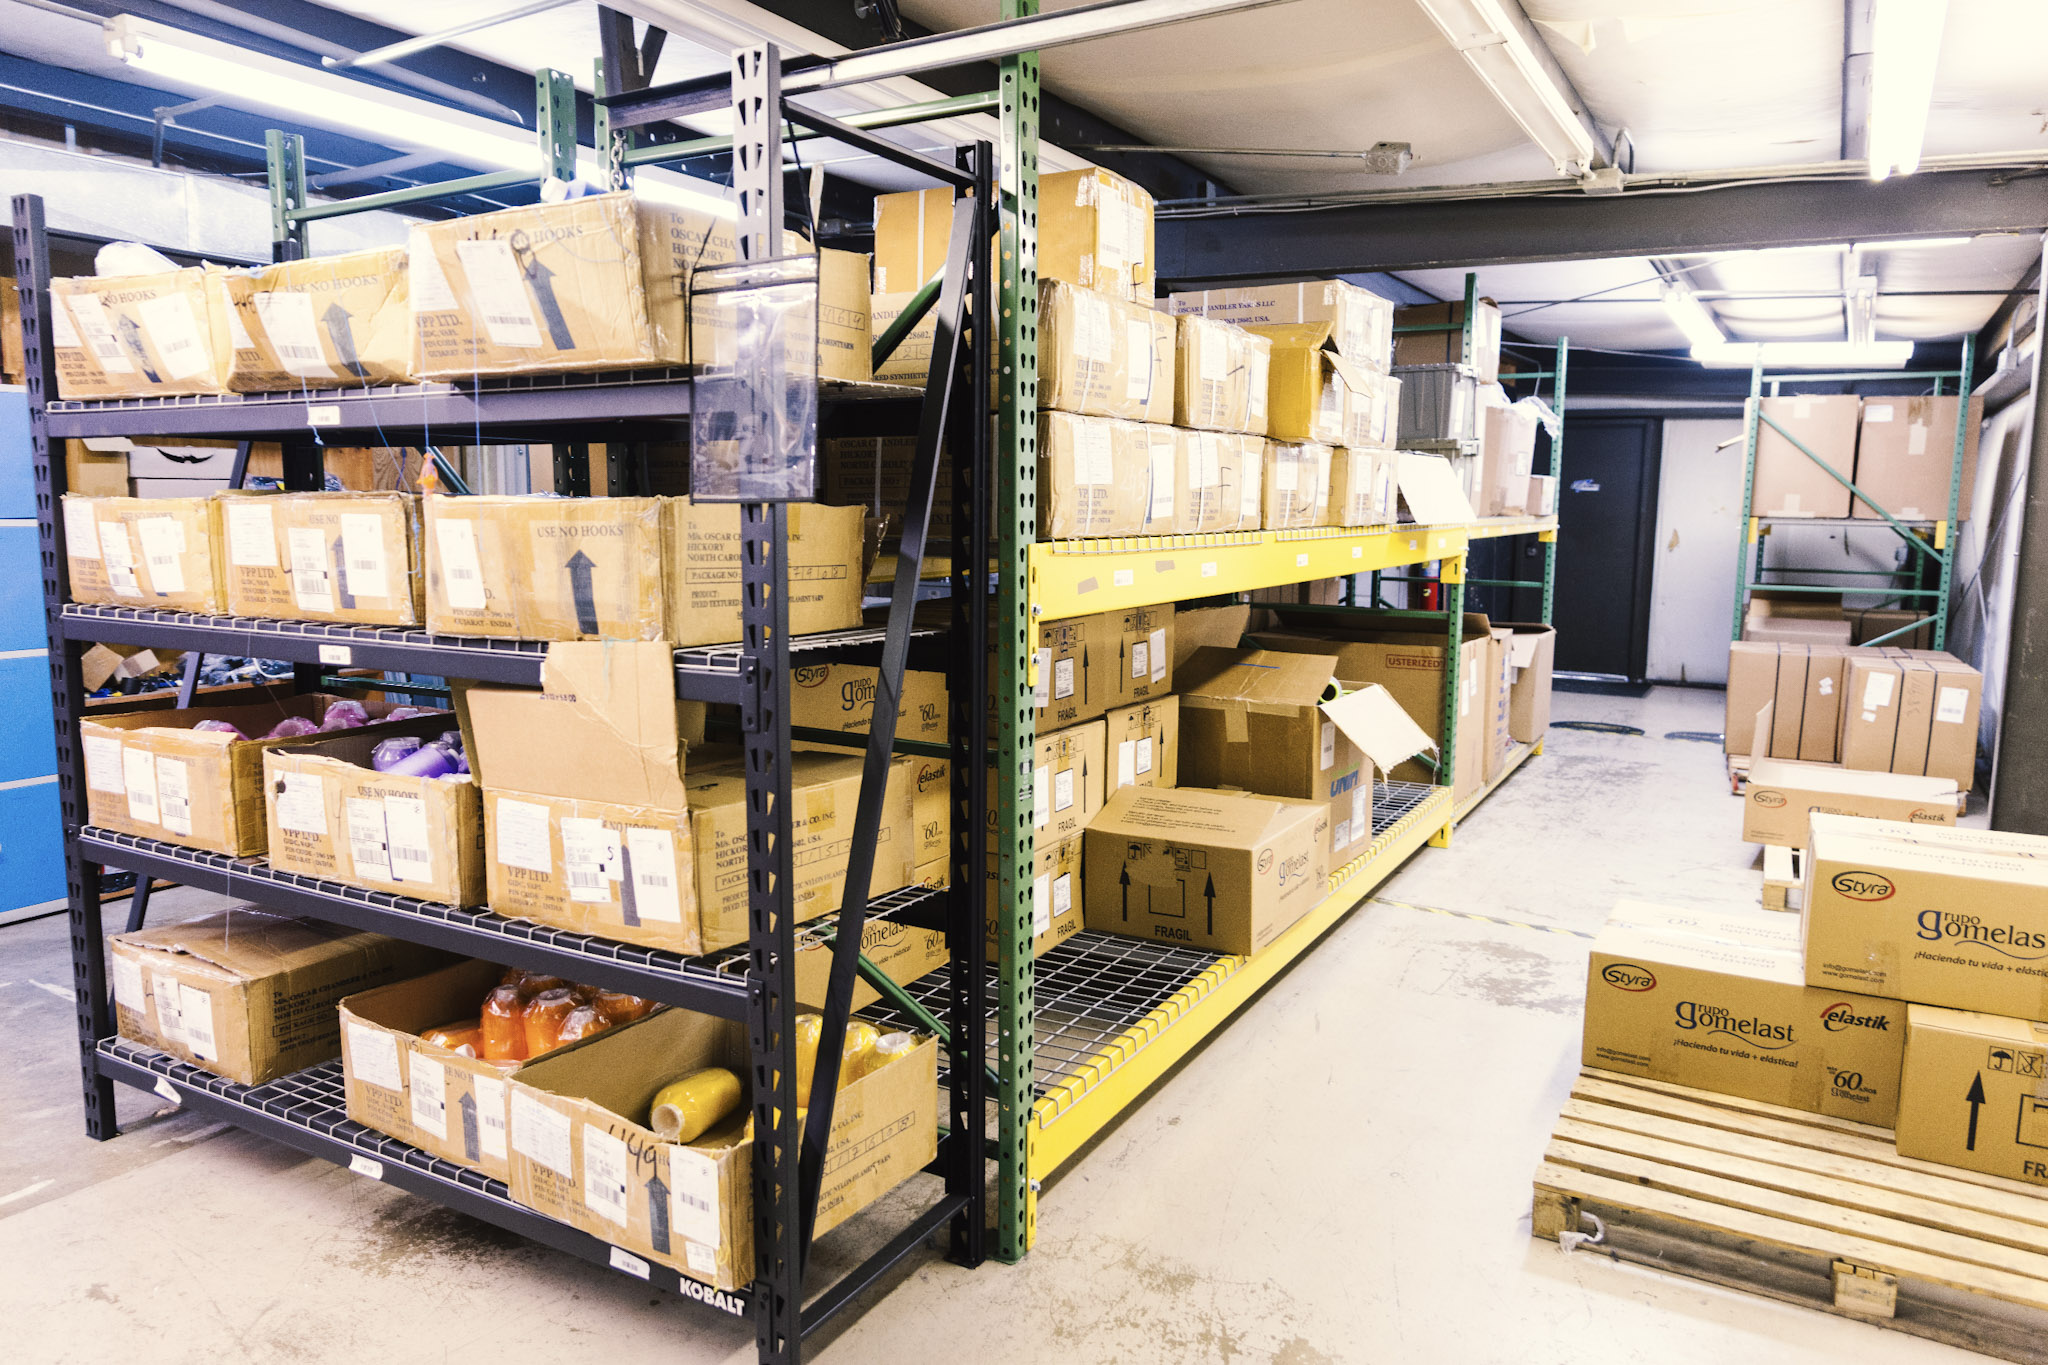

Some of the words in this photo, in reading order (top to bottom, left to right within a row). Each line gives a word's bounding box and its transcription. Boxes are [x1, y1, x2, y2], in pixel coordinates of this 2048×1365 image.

[534, 225, 583, 243] HOOKS
[333, 274, 378, 289] HOOKS
[1201, 302, 1237, 313] CANDLER
[537, 527, 556, 538] USE
[558, 526, 578, 537] NO
[583, 524, 624, 537] HOOKS
[704, 533, 731, 541] OSCAR
[1388, 656, 1441, 670] USTERIZED
[1134, 685, 1150, 699] FRAGIL
[1058, 706, 1077, 722] FRAGIL
[1058, 816, 1077, 834] FRAGIL
[1911, 810, 1946, 823] elastik
[508, 866, 528, 880] VPP
[1836, 877, 1891, 896] Styra
[1057, 919, 1077, 938] FRAGIL
[1154, 925, 1192, 942] FRAGIL
[1914, 950, 1967, 966] ¡Haciendo
[1968, 958, 1980, 968] tu
[1981, 959, 2004, 972] vida
[1606, 967, 1654, 989] Styra
[1824, 1009, 1891, 1032] elastik
[1673, 1037, 1718, 1054] ¡Haciendo
[1719, 1044, 1729, 1054] tu
[1730, 1046, 1751, 1060] vida
[1760, 1052, 1799, 1069] elástica!
[1833, 1069, 1864, 1092] 60
